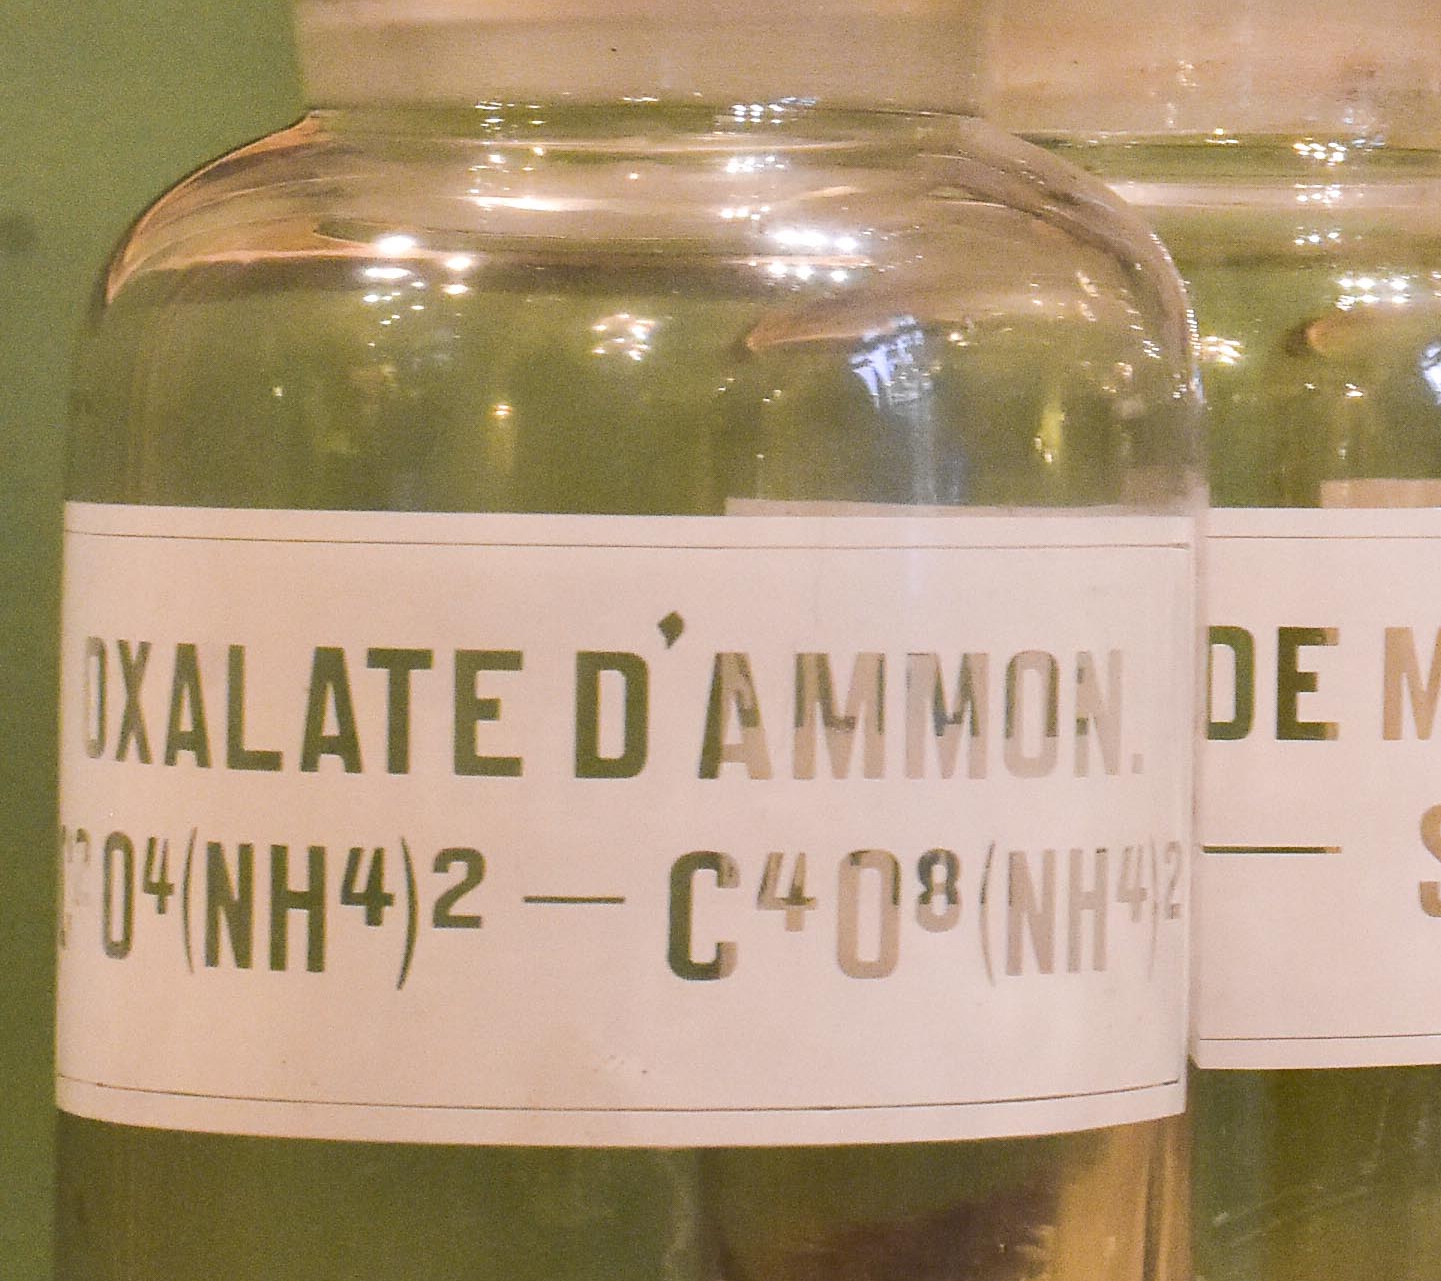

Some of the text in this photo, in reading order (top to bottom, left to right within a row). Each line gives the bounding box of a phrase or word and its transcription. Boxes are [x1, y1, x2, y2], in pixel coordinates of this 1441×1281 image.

[84, 610, 1144, 780] OXALATE D'AMMON.
[1207, 625, 1340, 741] DE
